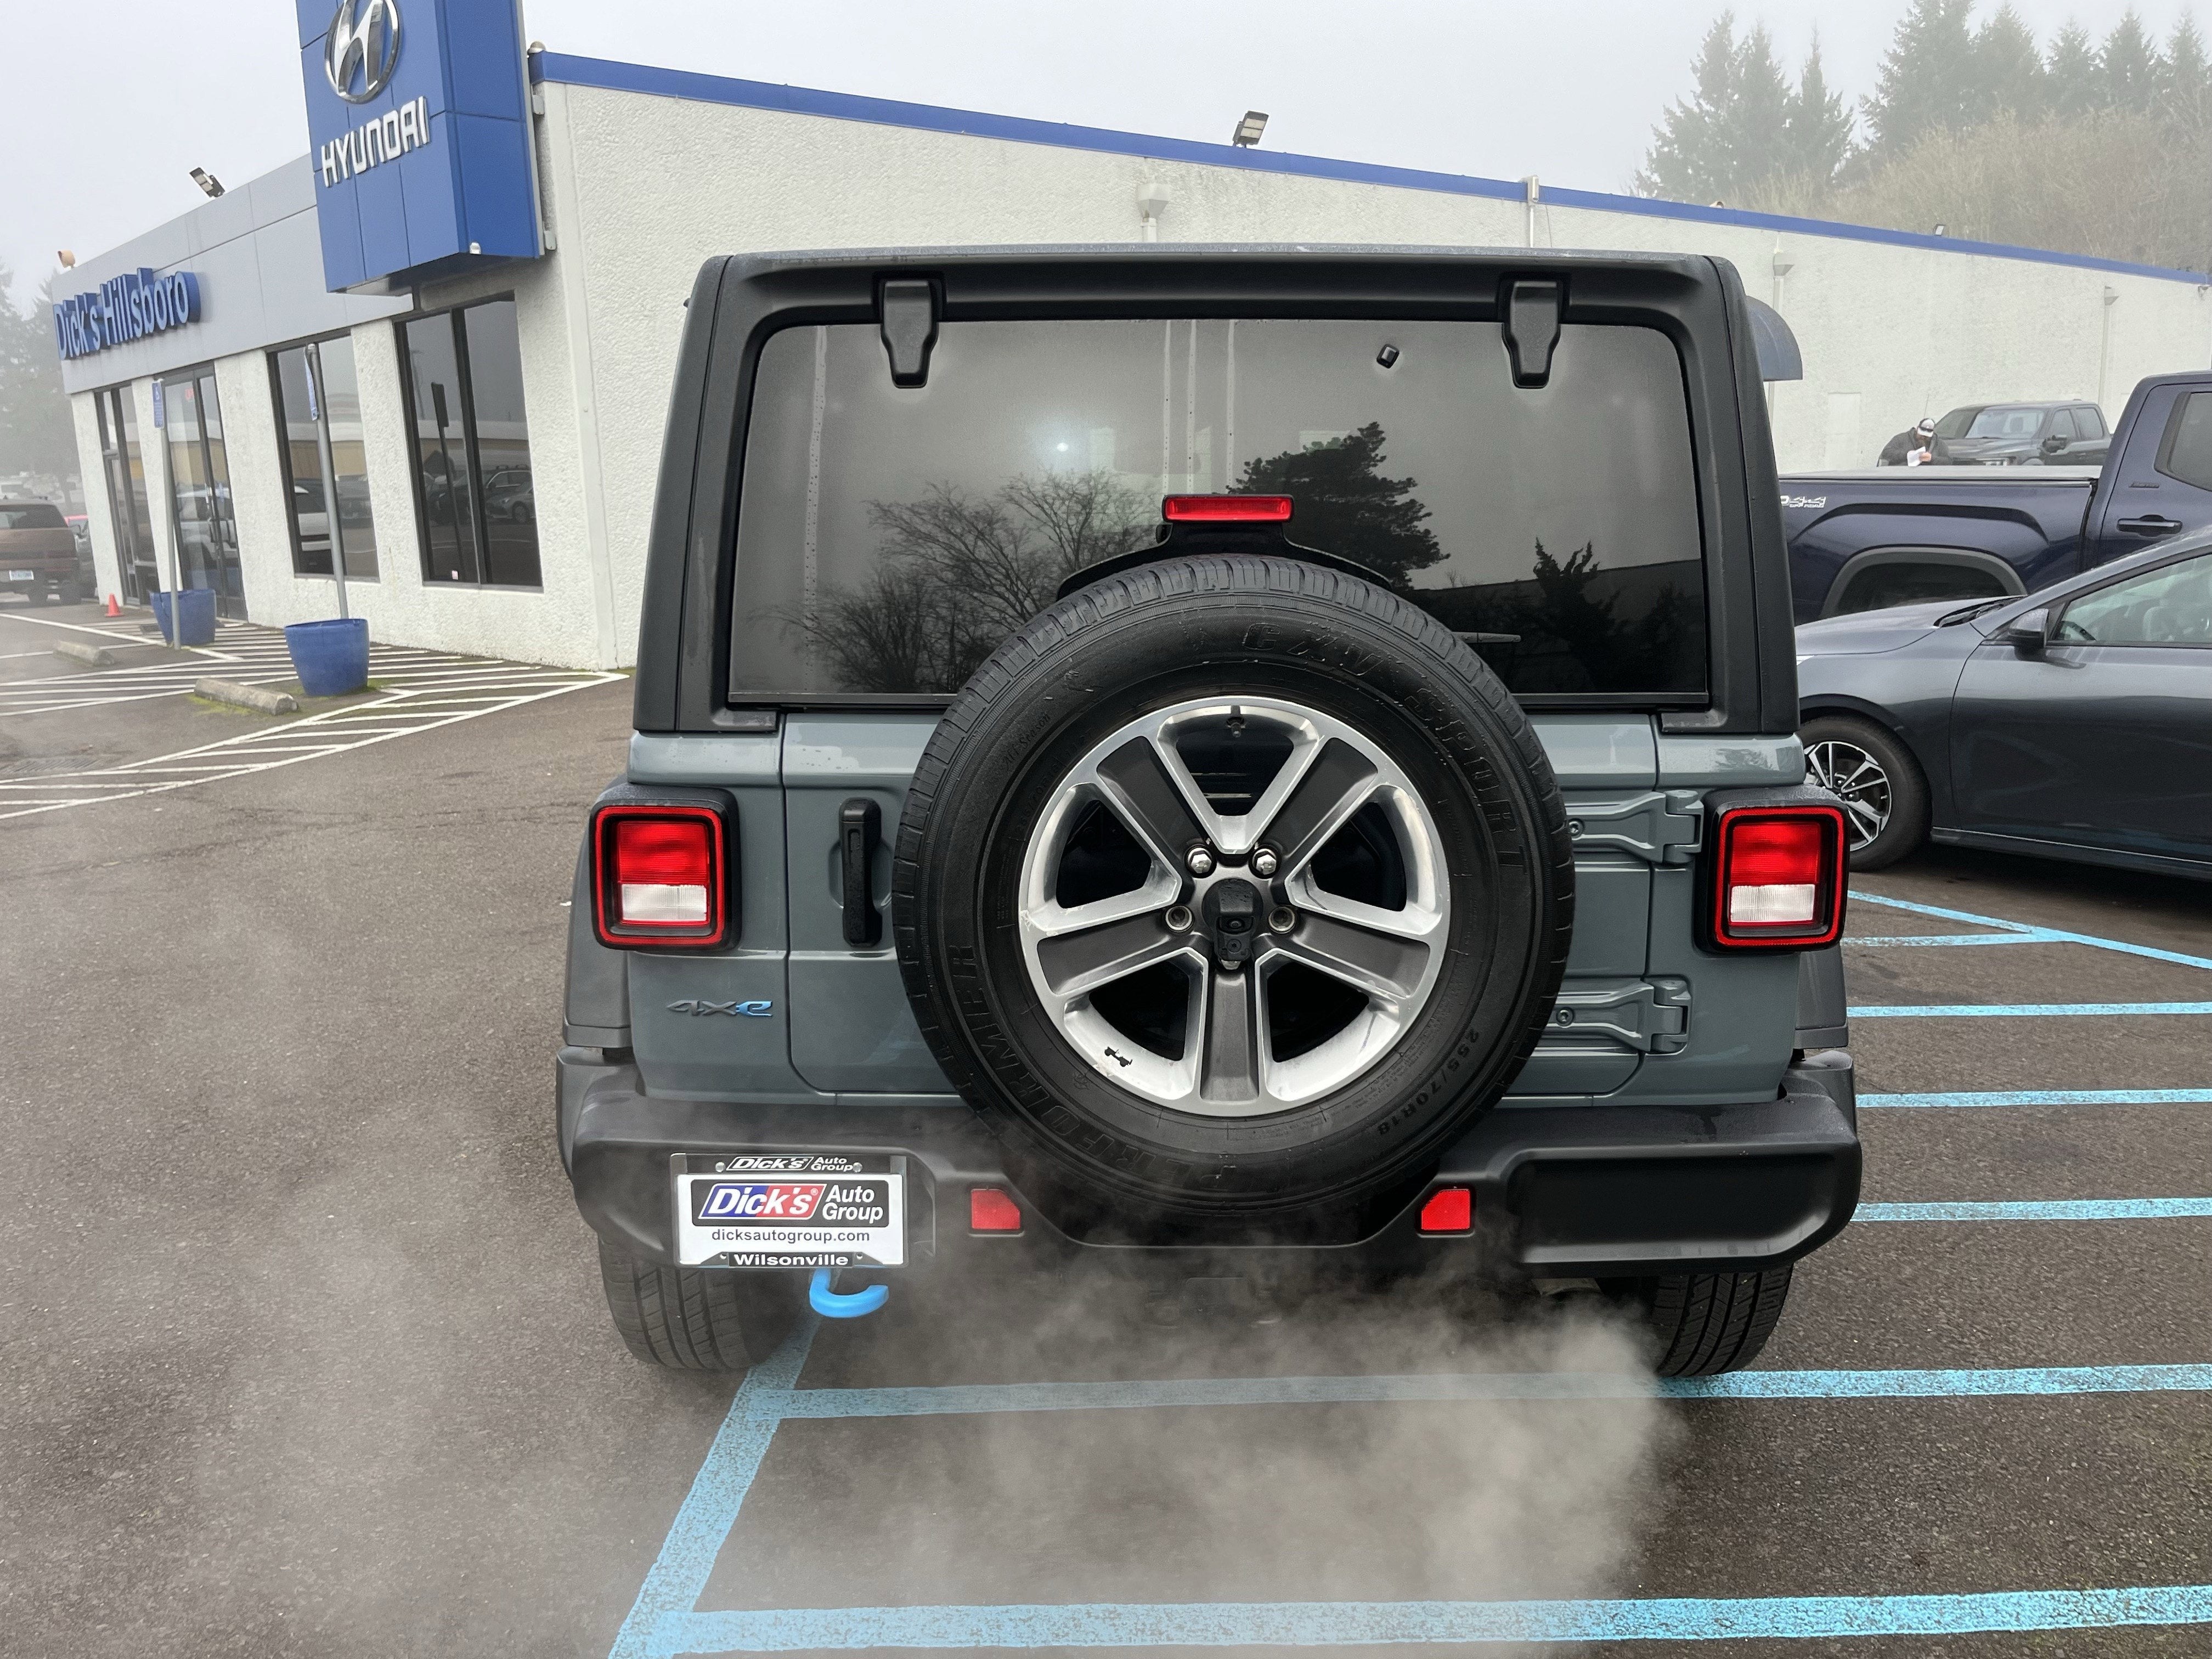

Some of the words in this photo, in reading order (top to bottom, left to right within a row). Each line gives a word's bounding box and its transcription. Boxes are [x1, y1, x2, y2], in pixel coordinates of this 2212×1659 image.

[320, 95, 430, 188] HYUNDAI
[53, 293, 101, 361] Dick's
[100, 267, 193, 347] Hillsboro
[1403, 688, 1526, 874] SPORT
[947, 944, 1239, 1192] PERFORMER
[1375, 1028, 1481, 1136] 255/70R18
[732, 1158, 805, 1169] Dick's
[810, 1163, 853, 1172] Group
[708, 1187, 813, 1215] Dick's
[825, 1184, 874, 1203] Auto
[822, 1202, 884, 1224] Group
[712, 1229, 870, 1244] dicksautogroup.com
[733, 1253, 849, 1266] Wilsonville
